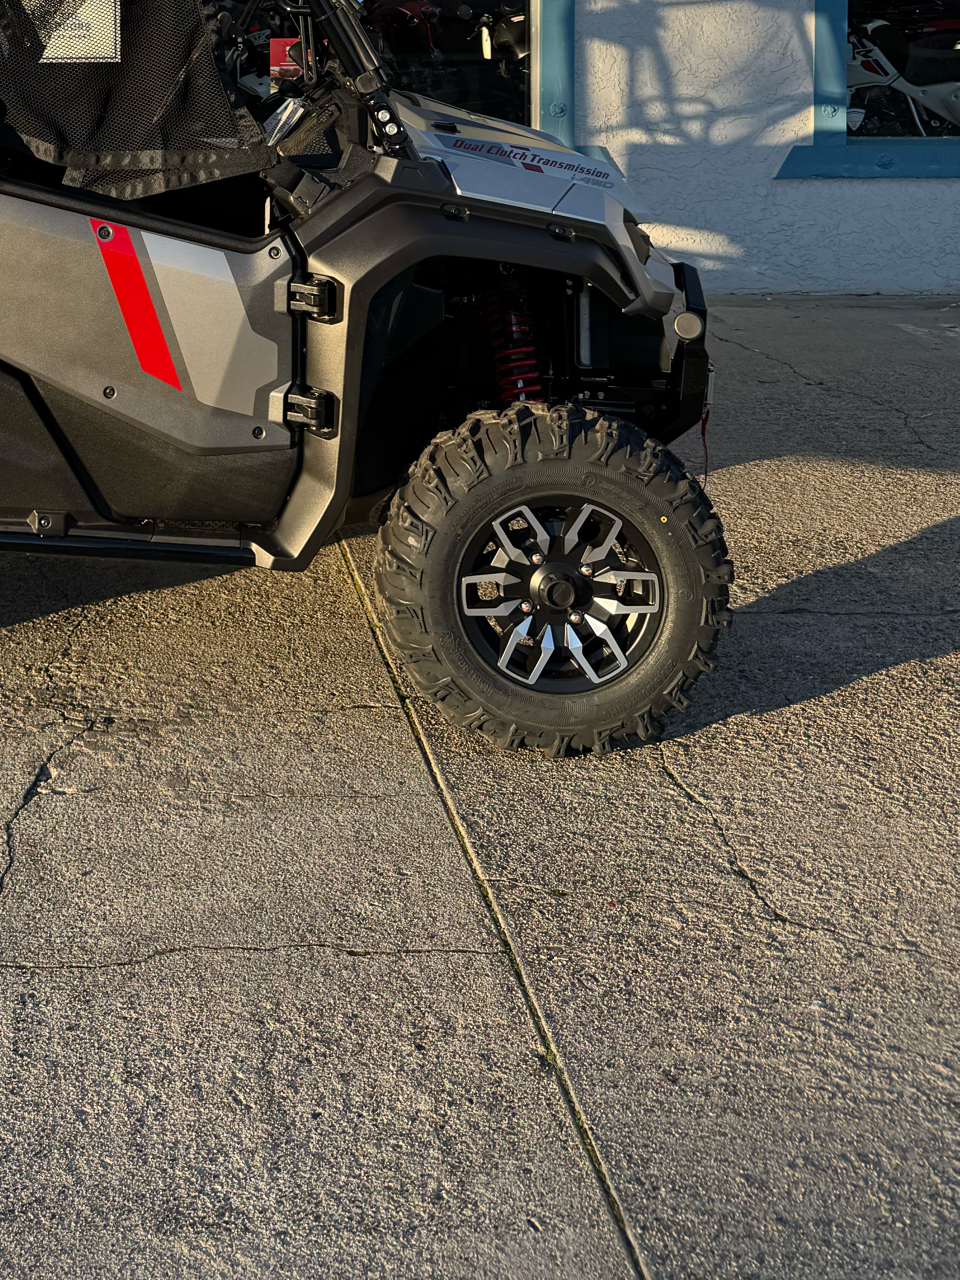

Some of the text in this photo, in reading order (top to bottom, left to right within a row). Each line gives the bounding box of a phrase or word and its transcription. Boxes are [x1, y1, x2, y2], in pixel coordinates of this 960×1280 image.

[452, 138, 610, 180] Dual Clutch Transmission
